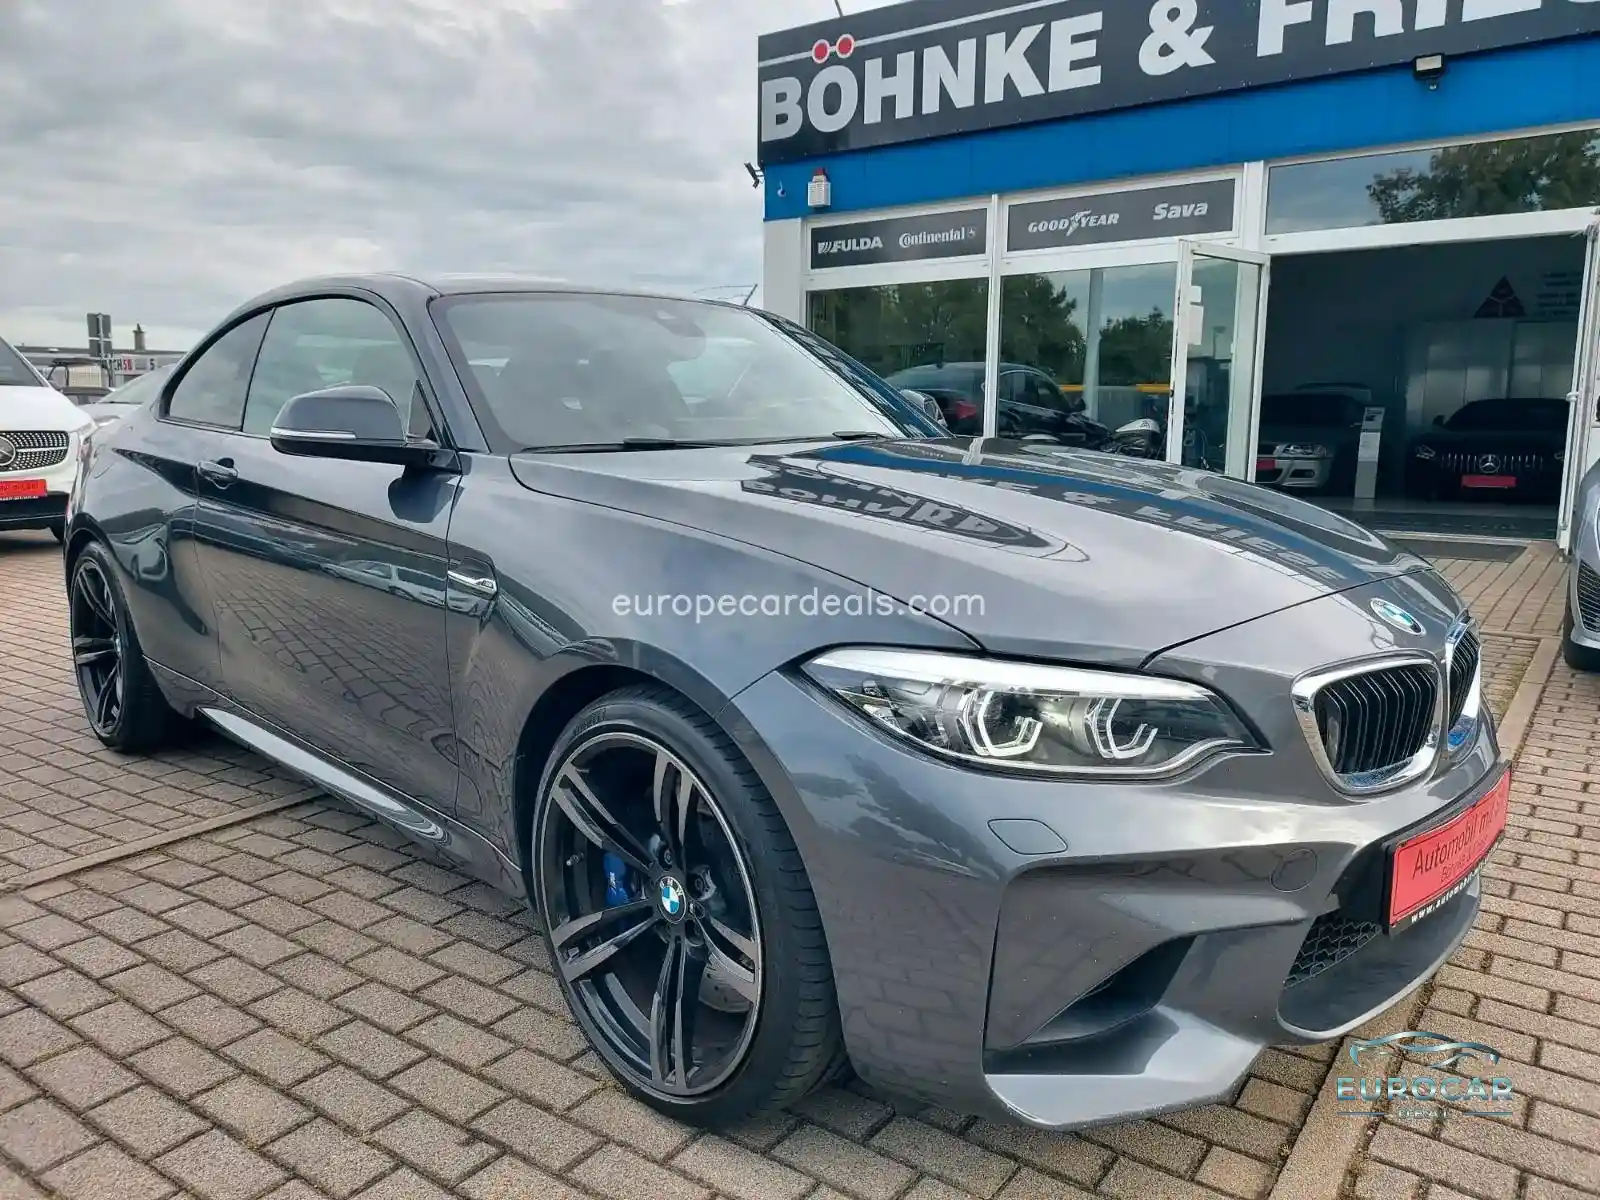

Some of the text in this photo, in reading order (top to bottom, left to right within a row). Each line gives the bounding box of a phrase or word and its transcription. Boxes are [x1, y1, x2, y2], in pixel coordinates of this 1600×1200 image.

[761, 11, 1103, 142] BÖHNKE
[1139, 0, 1215, 75] &
[829, 227, 965, 254] FULDA Continental
[1028, 201, 1208, 237] GOODYEAR Sava
[1412, 813, 1478, 879] Automobil
